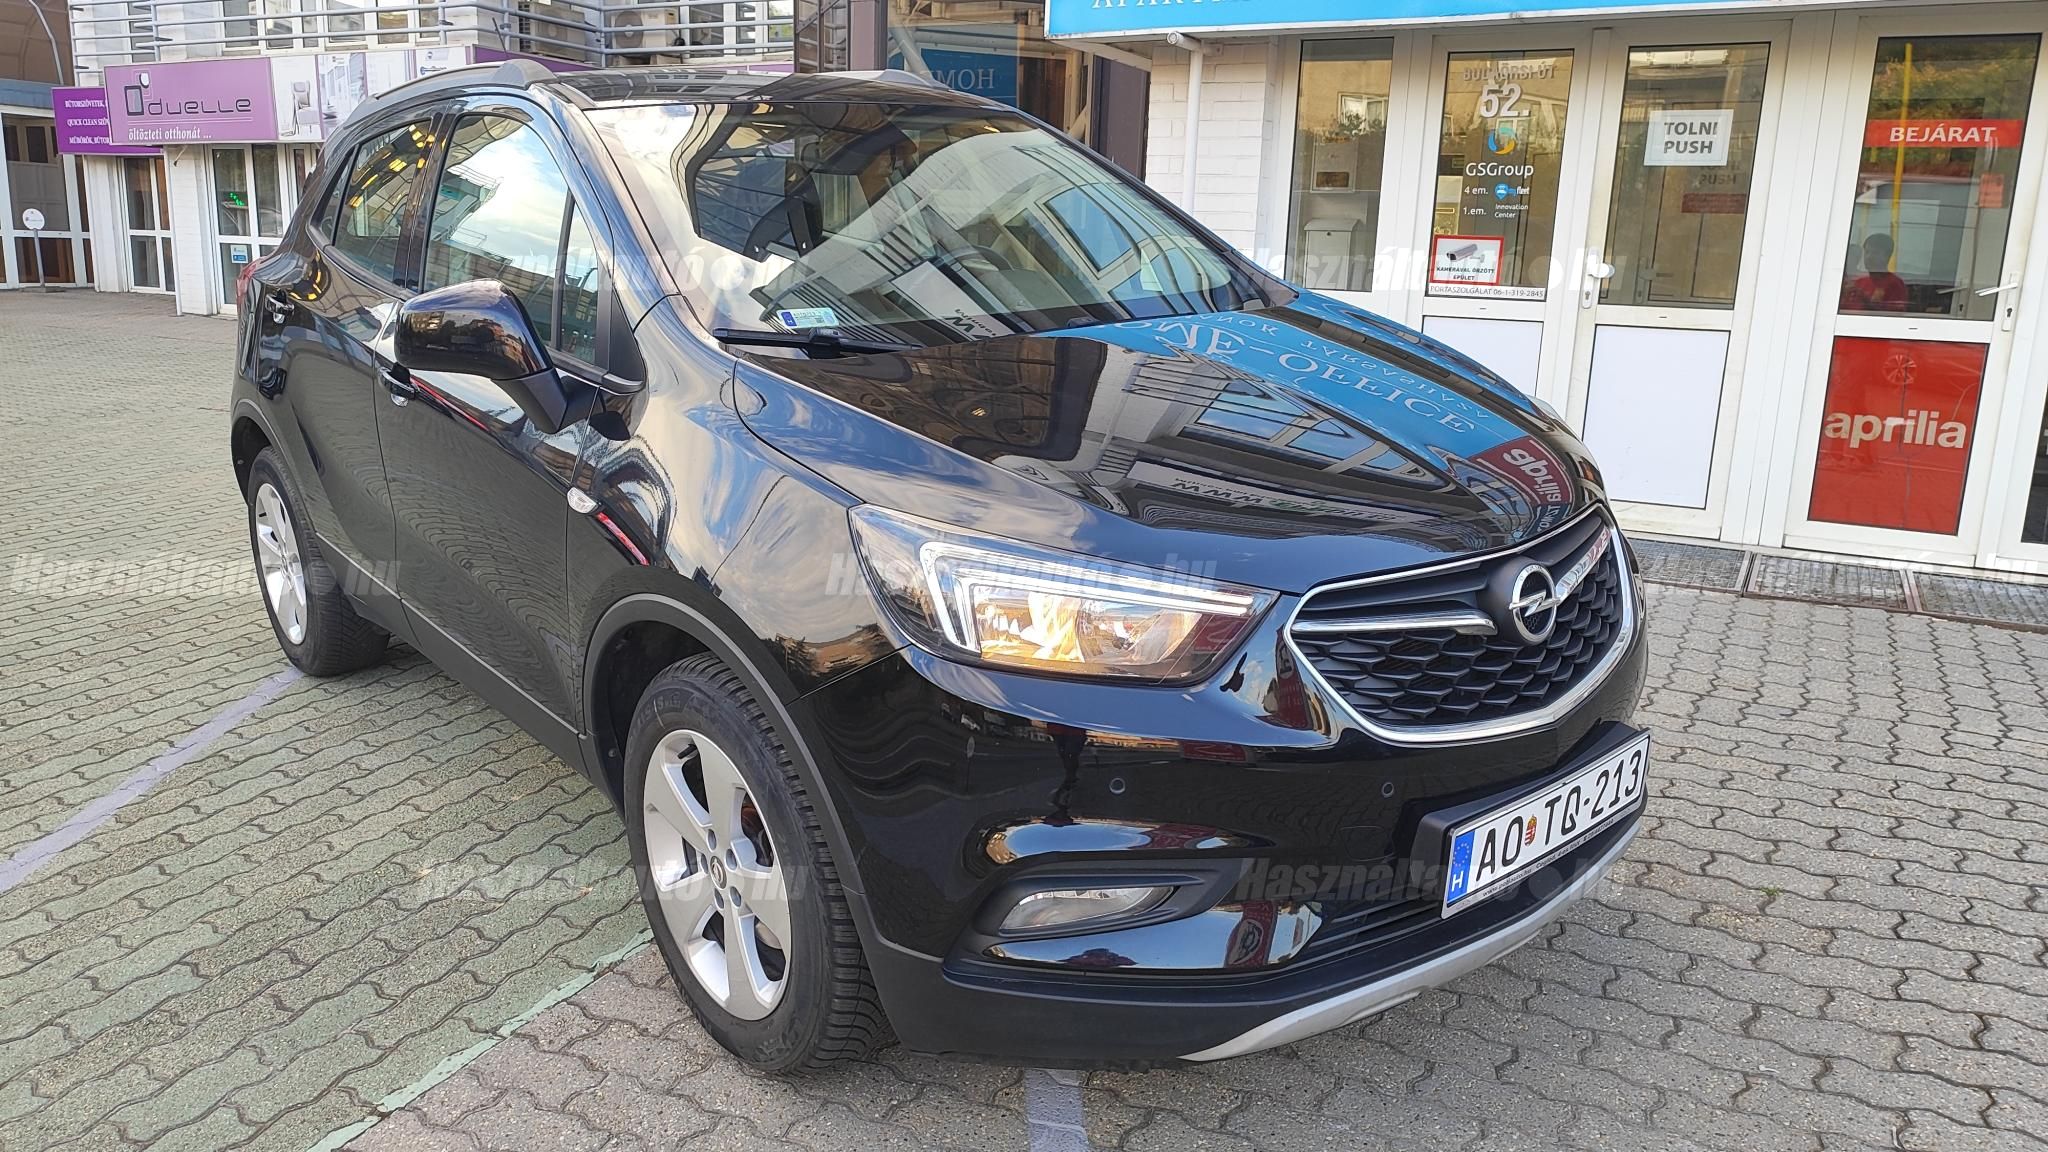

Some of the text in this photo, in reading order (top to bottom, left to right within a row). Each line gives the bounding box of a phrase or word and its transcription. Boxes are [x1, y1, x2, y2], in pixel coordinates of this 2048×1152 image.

[1479, 82, 1531, 118] 52.
[164, 125, 202, 139] otthonát
[1663, 121, 1718, 136] TOLNI
[1890, 123, 1997, 143] BEJÁRAT
[1663, 140, 1714, 154] PUSH
[1465, 162, 1534, 179] GSGroup
[1494, 211, 1516, 219] Center
[1430, 285, 1493, 296] PORTASZOLGÁLAT
[1824, 409, 1967, 449] aprilia
[1475, 815, 1524, 882] AO
[1451, 871, 1465, 892] H
